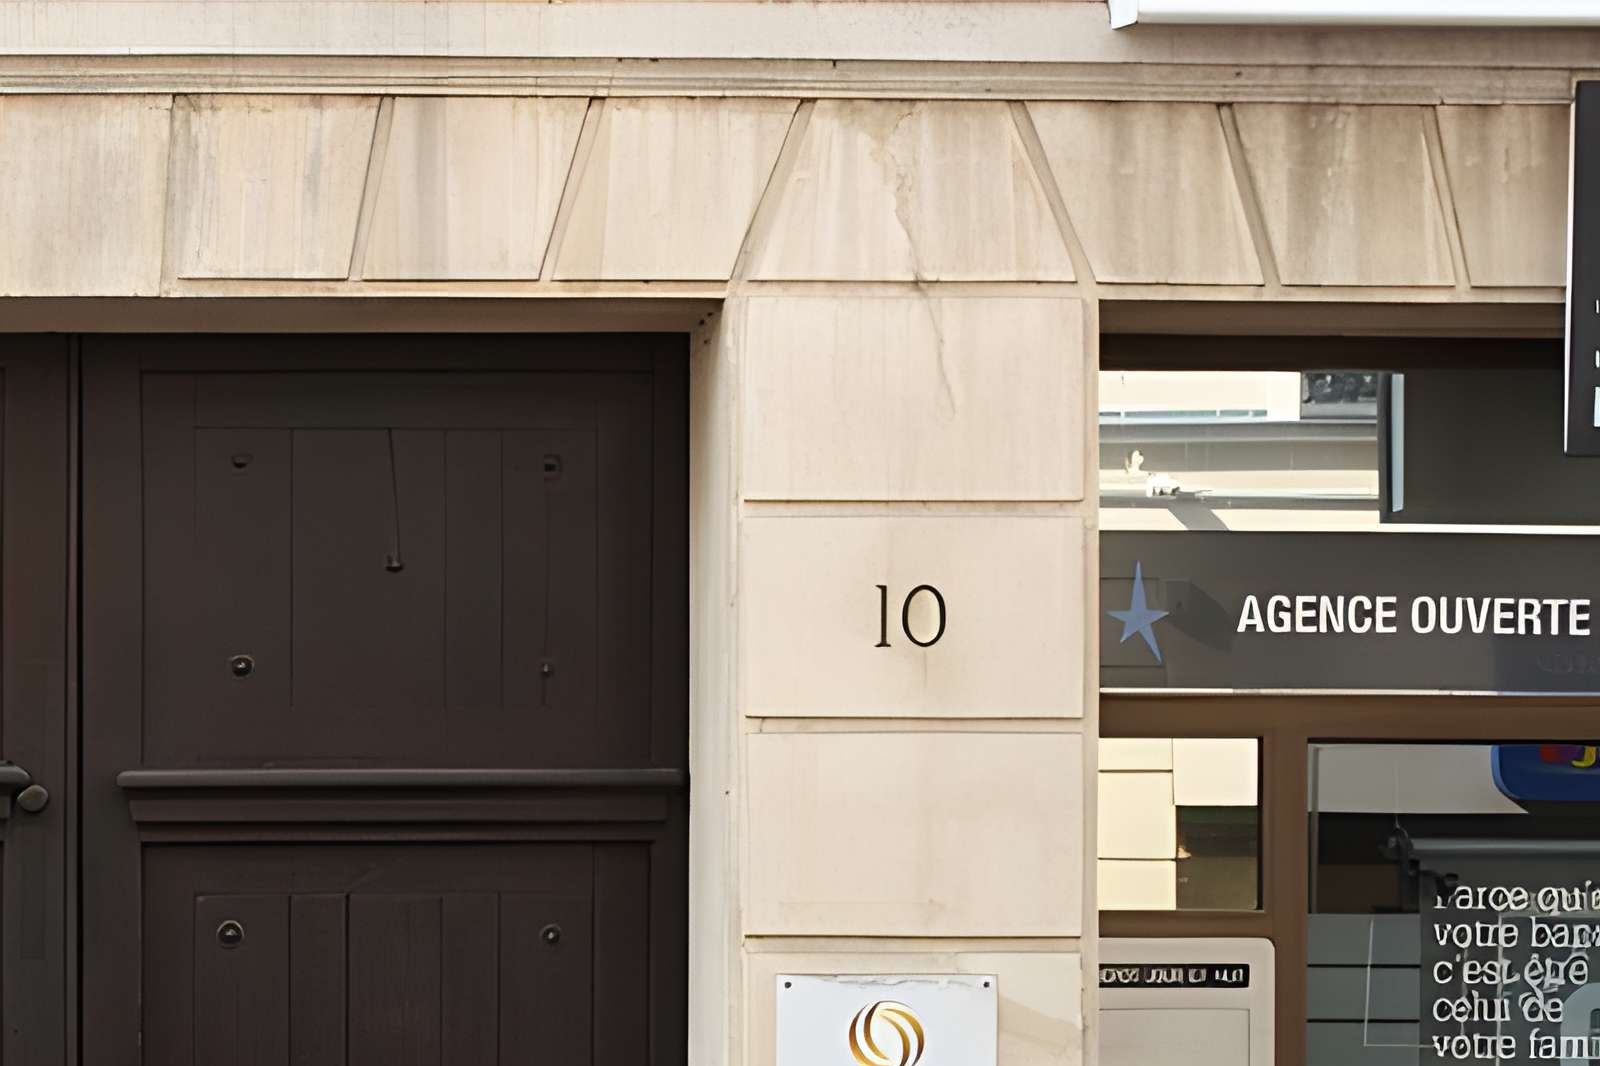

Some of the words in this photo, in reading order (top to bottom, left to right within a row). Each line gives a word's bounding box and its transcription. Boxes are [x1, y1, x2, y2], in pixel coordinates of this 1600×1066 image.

[874, 584, 947, 648] 10
[1236, 595, 1398, 633] AGENCE
[1411, 596, 1591, 636] OUVERTE
